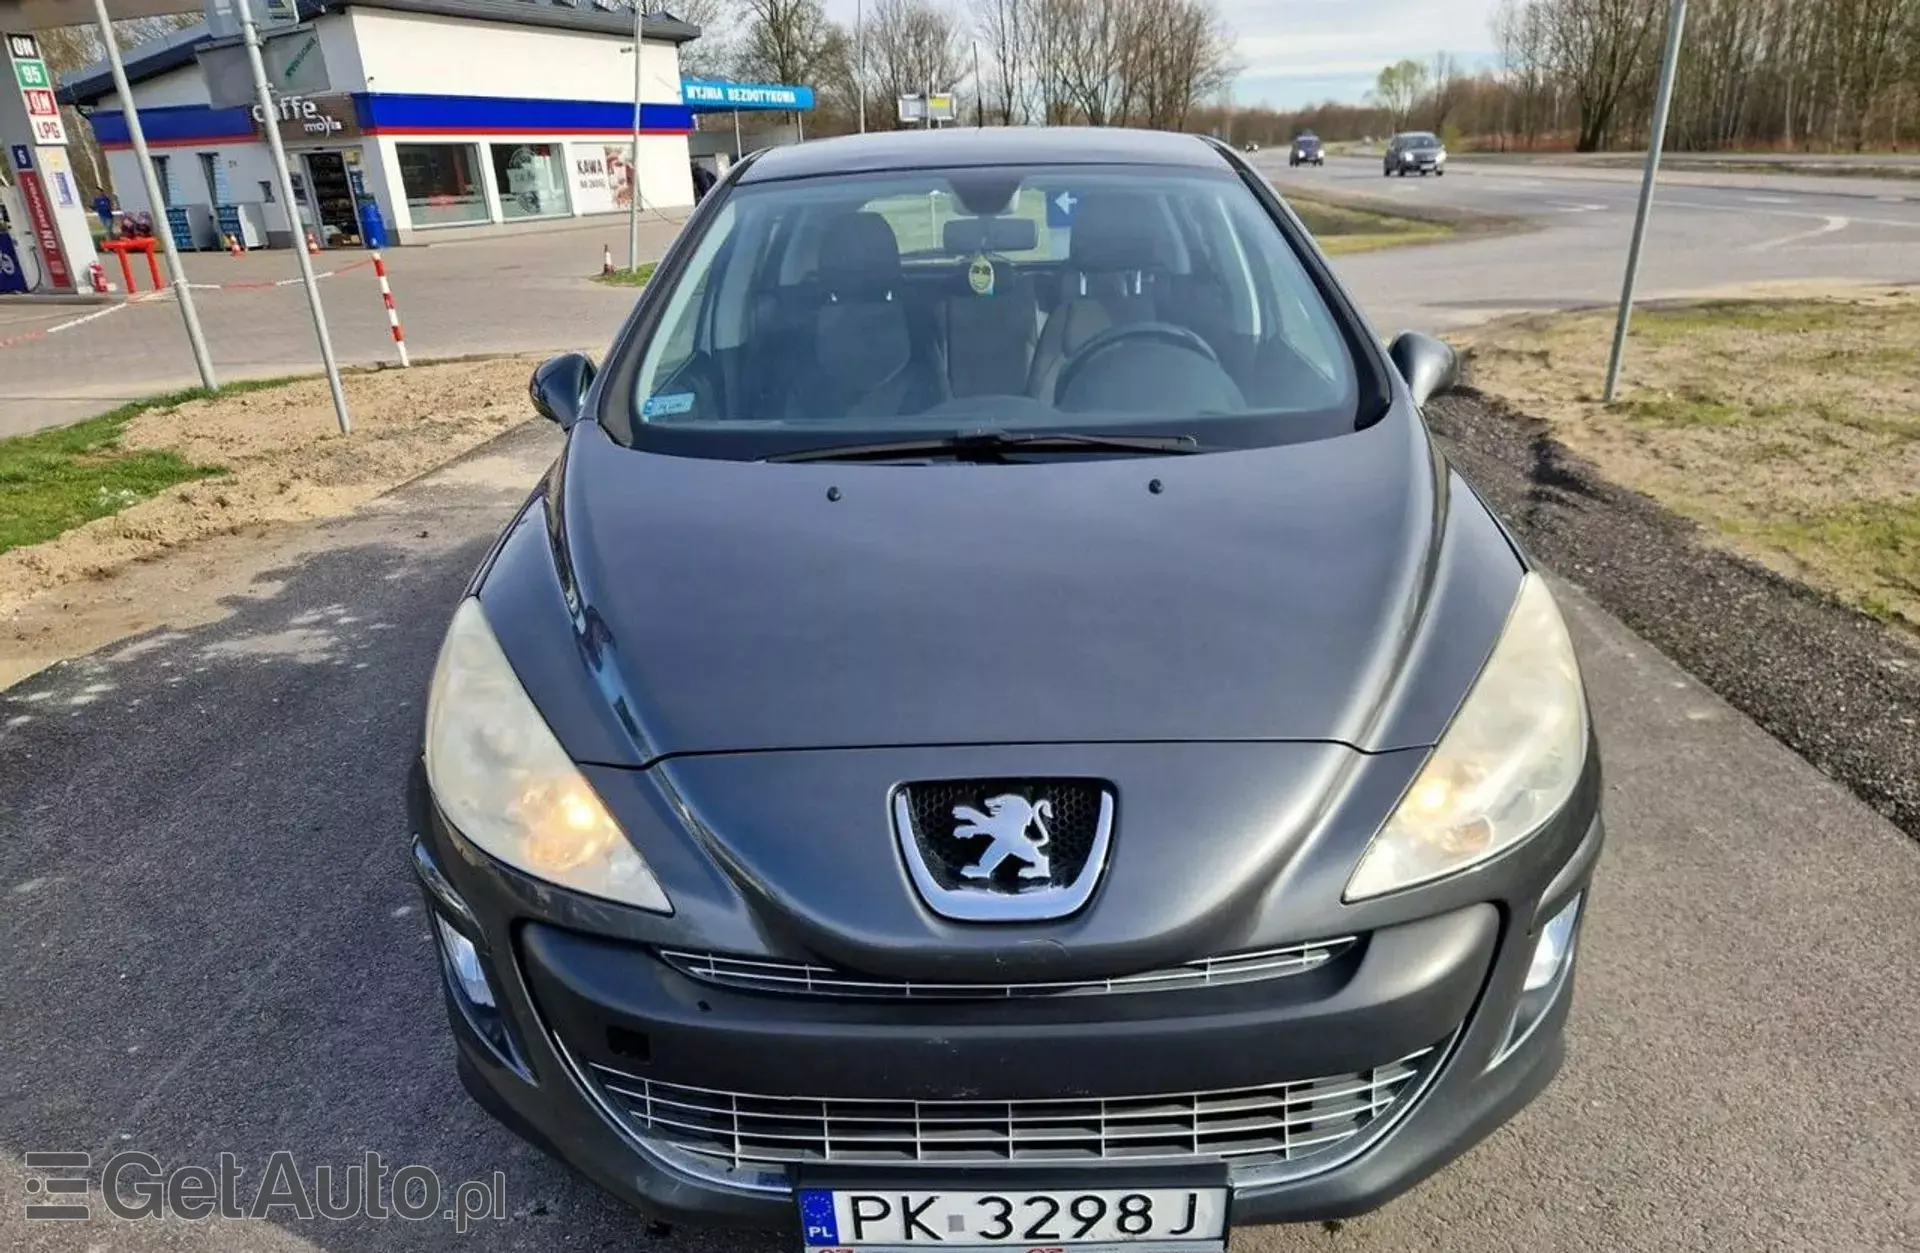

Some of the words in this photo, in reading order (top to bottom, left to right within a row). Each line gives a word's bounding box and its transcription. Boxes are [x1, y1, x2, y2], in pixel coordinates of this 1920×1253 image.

[12, 37, 35, 56] ON
[22, 65, 42, 83] 95
[36, 121, 60, 139] LPG
[850, 1195, 942, 1240] PK
[977, 1193, 1198, 1240] 3298J
[808, 1226, 834, 1238] PL
